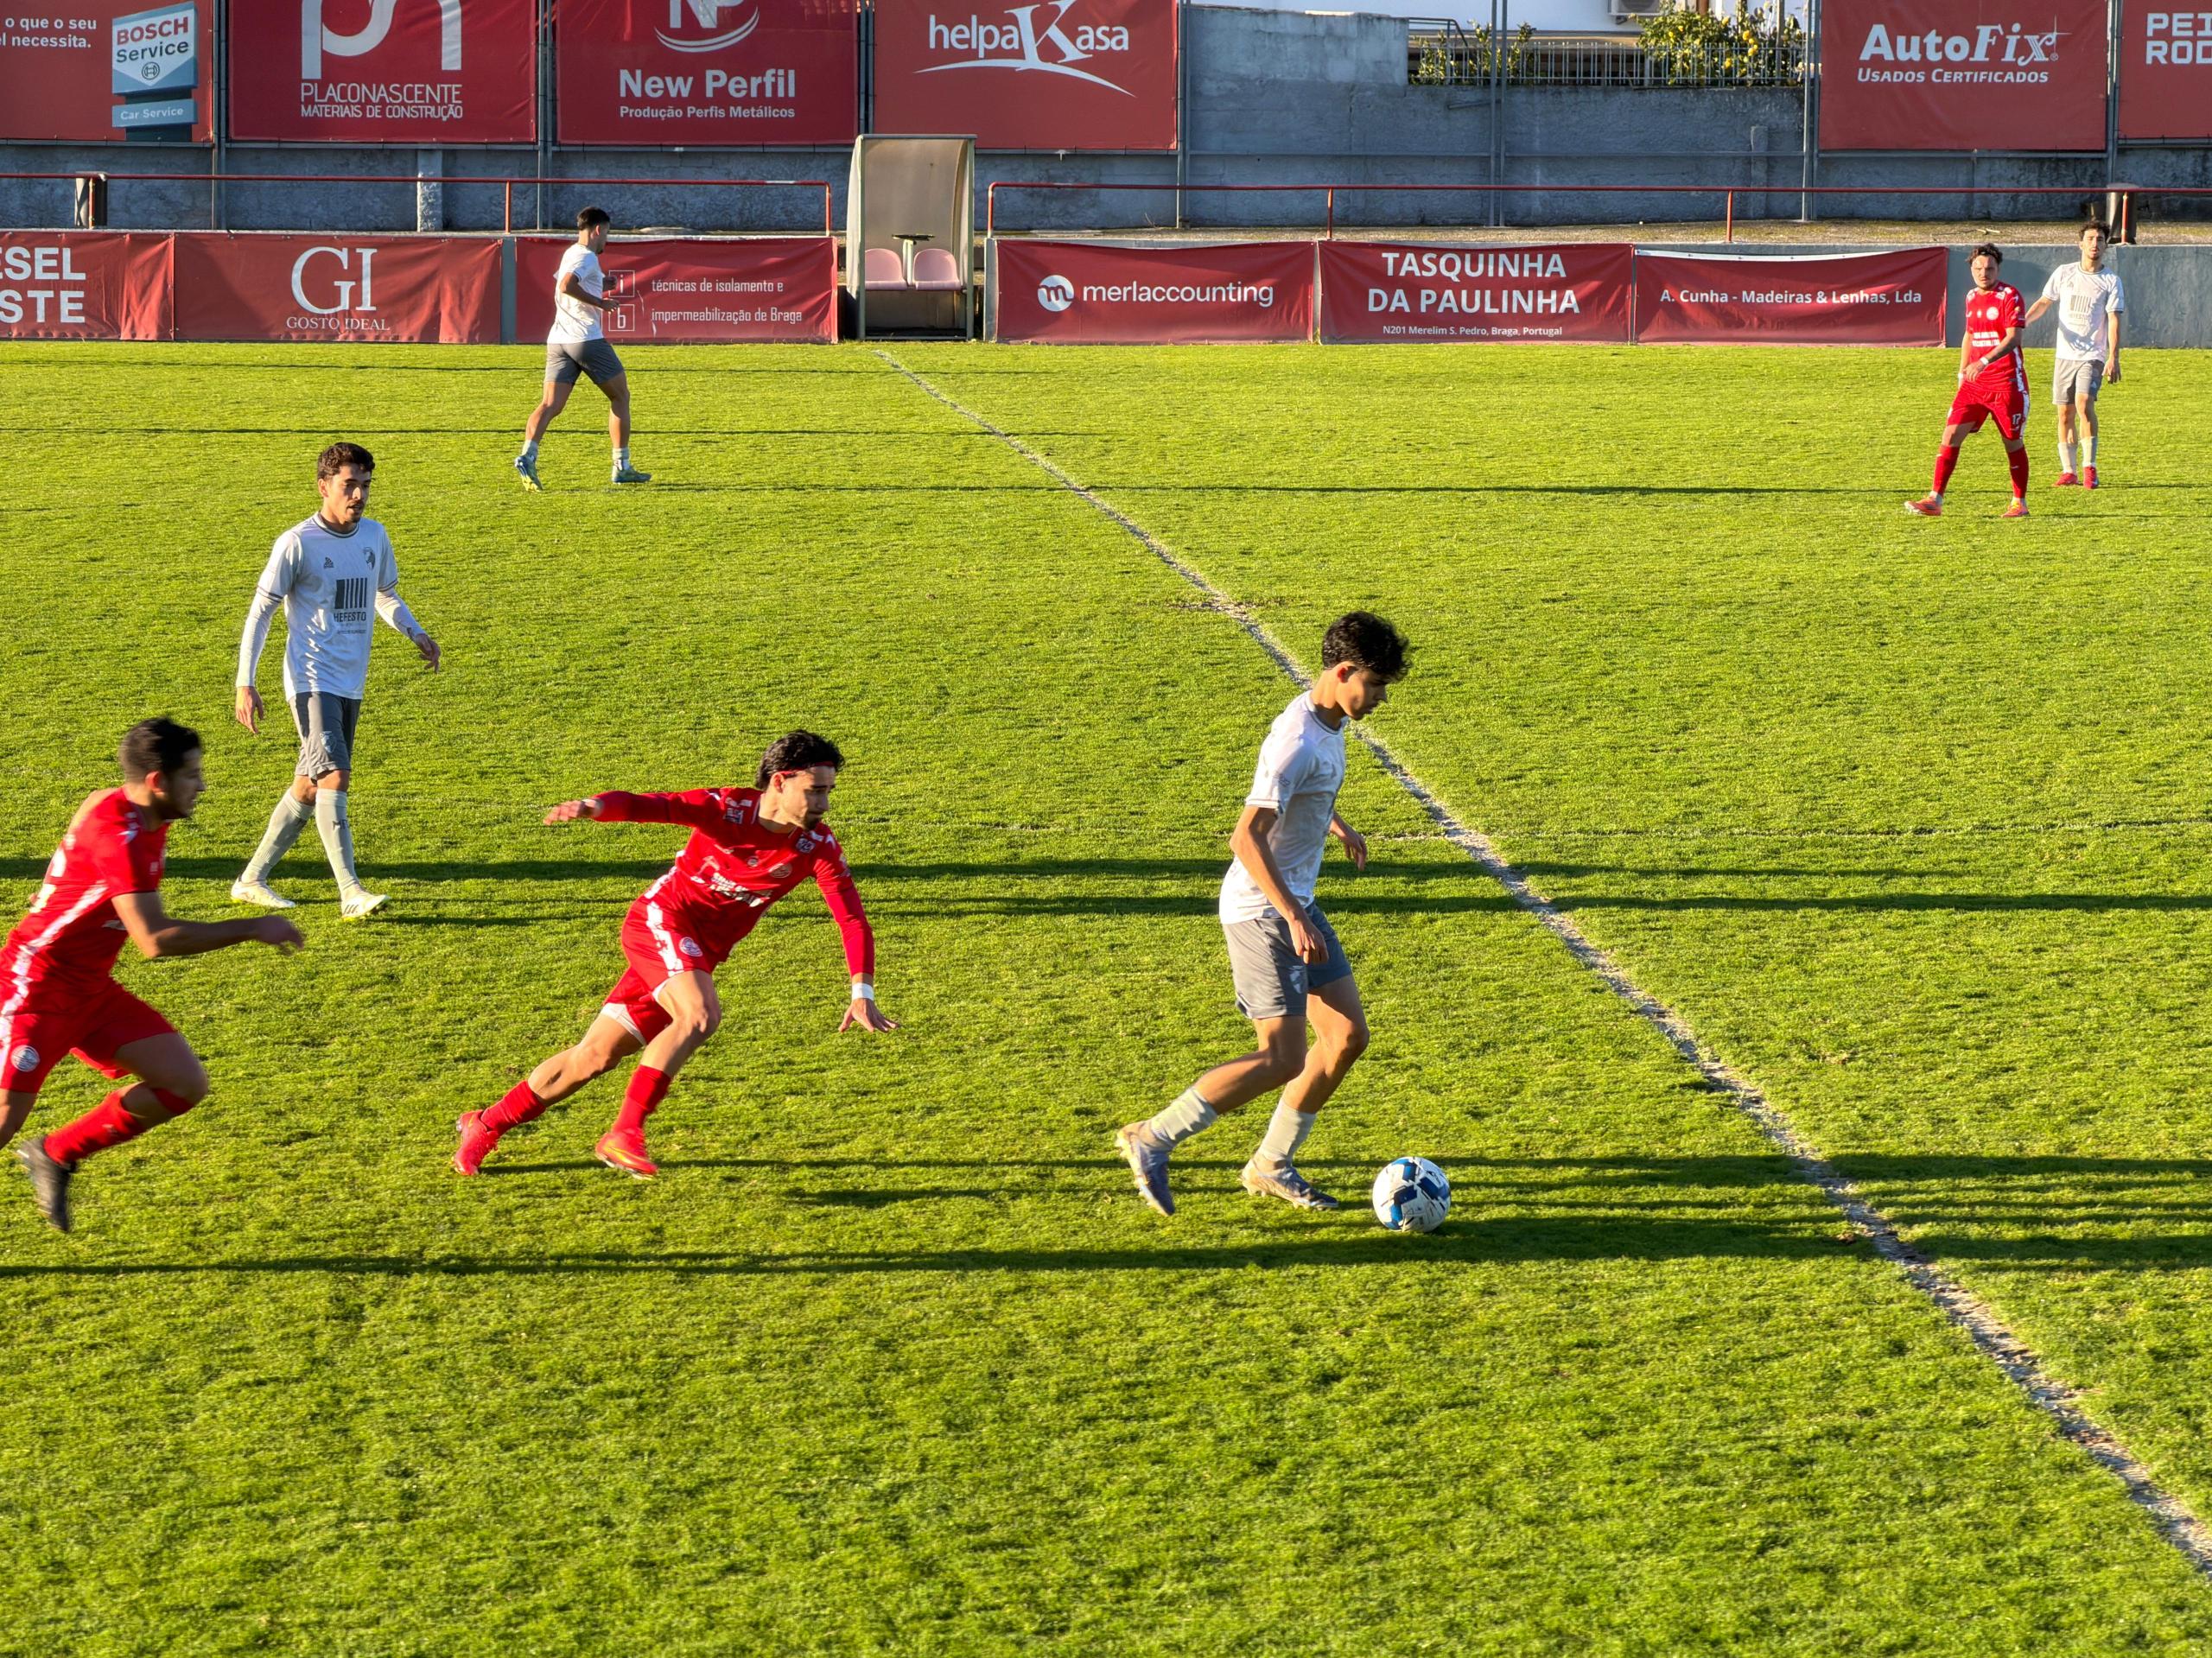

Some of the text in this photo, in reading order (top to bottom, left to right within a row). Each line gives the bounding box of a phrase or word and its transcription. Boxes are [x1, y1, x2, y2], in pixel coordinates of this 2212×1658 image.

[5, 18, 96, 31] o que o seu
[116, 16, 189, 47] BOSCH
[12, 35, 91, 48] necessita.
[115, 40, 189, 63] Service
[620, 69, 795, 98] New Perfil
[1858, 68, 2048, 83] USADOS CERTIFICADOS
[299, 80, 463, 104] PLACONASCENTE
[119, 105, 185, 121] Car Service
[300, 103, 464, 122] MATERIAIS DE CONSTRUÇÃO
[620, 105, 795, 120] Produção Perfis Metálicos
[0, 245, 87, 282] SEL
[1382, 253, 1566, 282] TASQUINHA
[290, 245, 378, 314] GI
[652, 278, 783, 291] técnicas de isolamento e
[1084, 281, 1273, 307] merlaccounting
[1369, 289, 1580, 313] DA PAULINHA
[1659, 289, 1675, 304] A.
[1679, 289, 1729, 304] Cunha
[1741, 289, 1813, 304] Madeiras
[1815, 290, 1829, 304] &
[1831, 289, 1891, 306] Lenhas,
[1894, 289, 1923, 304] Lda
[285, 316, 391, 331] GOSTO IDEAL
[652, 308, 802, 324] impermeabilização de Braga
[1459, 327, 1489, 336] Pedro,
[1491, 327, 1521, 336] Braga,
[1523, 327, 1562, 337] Portugal
[334, 612, 366, 622] HEFESTO
